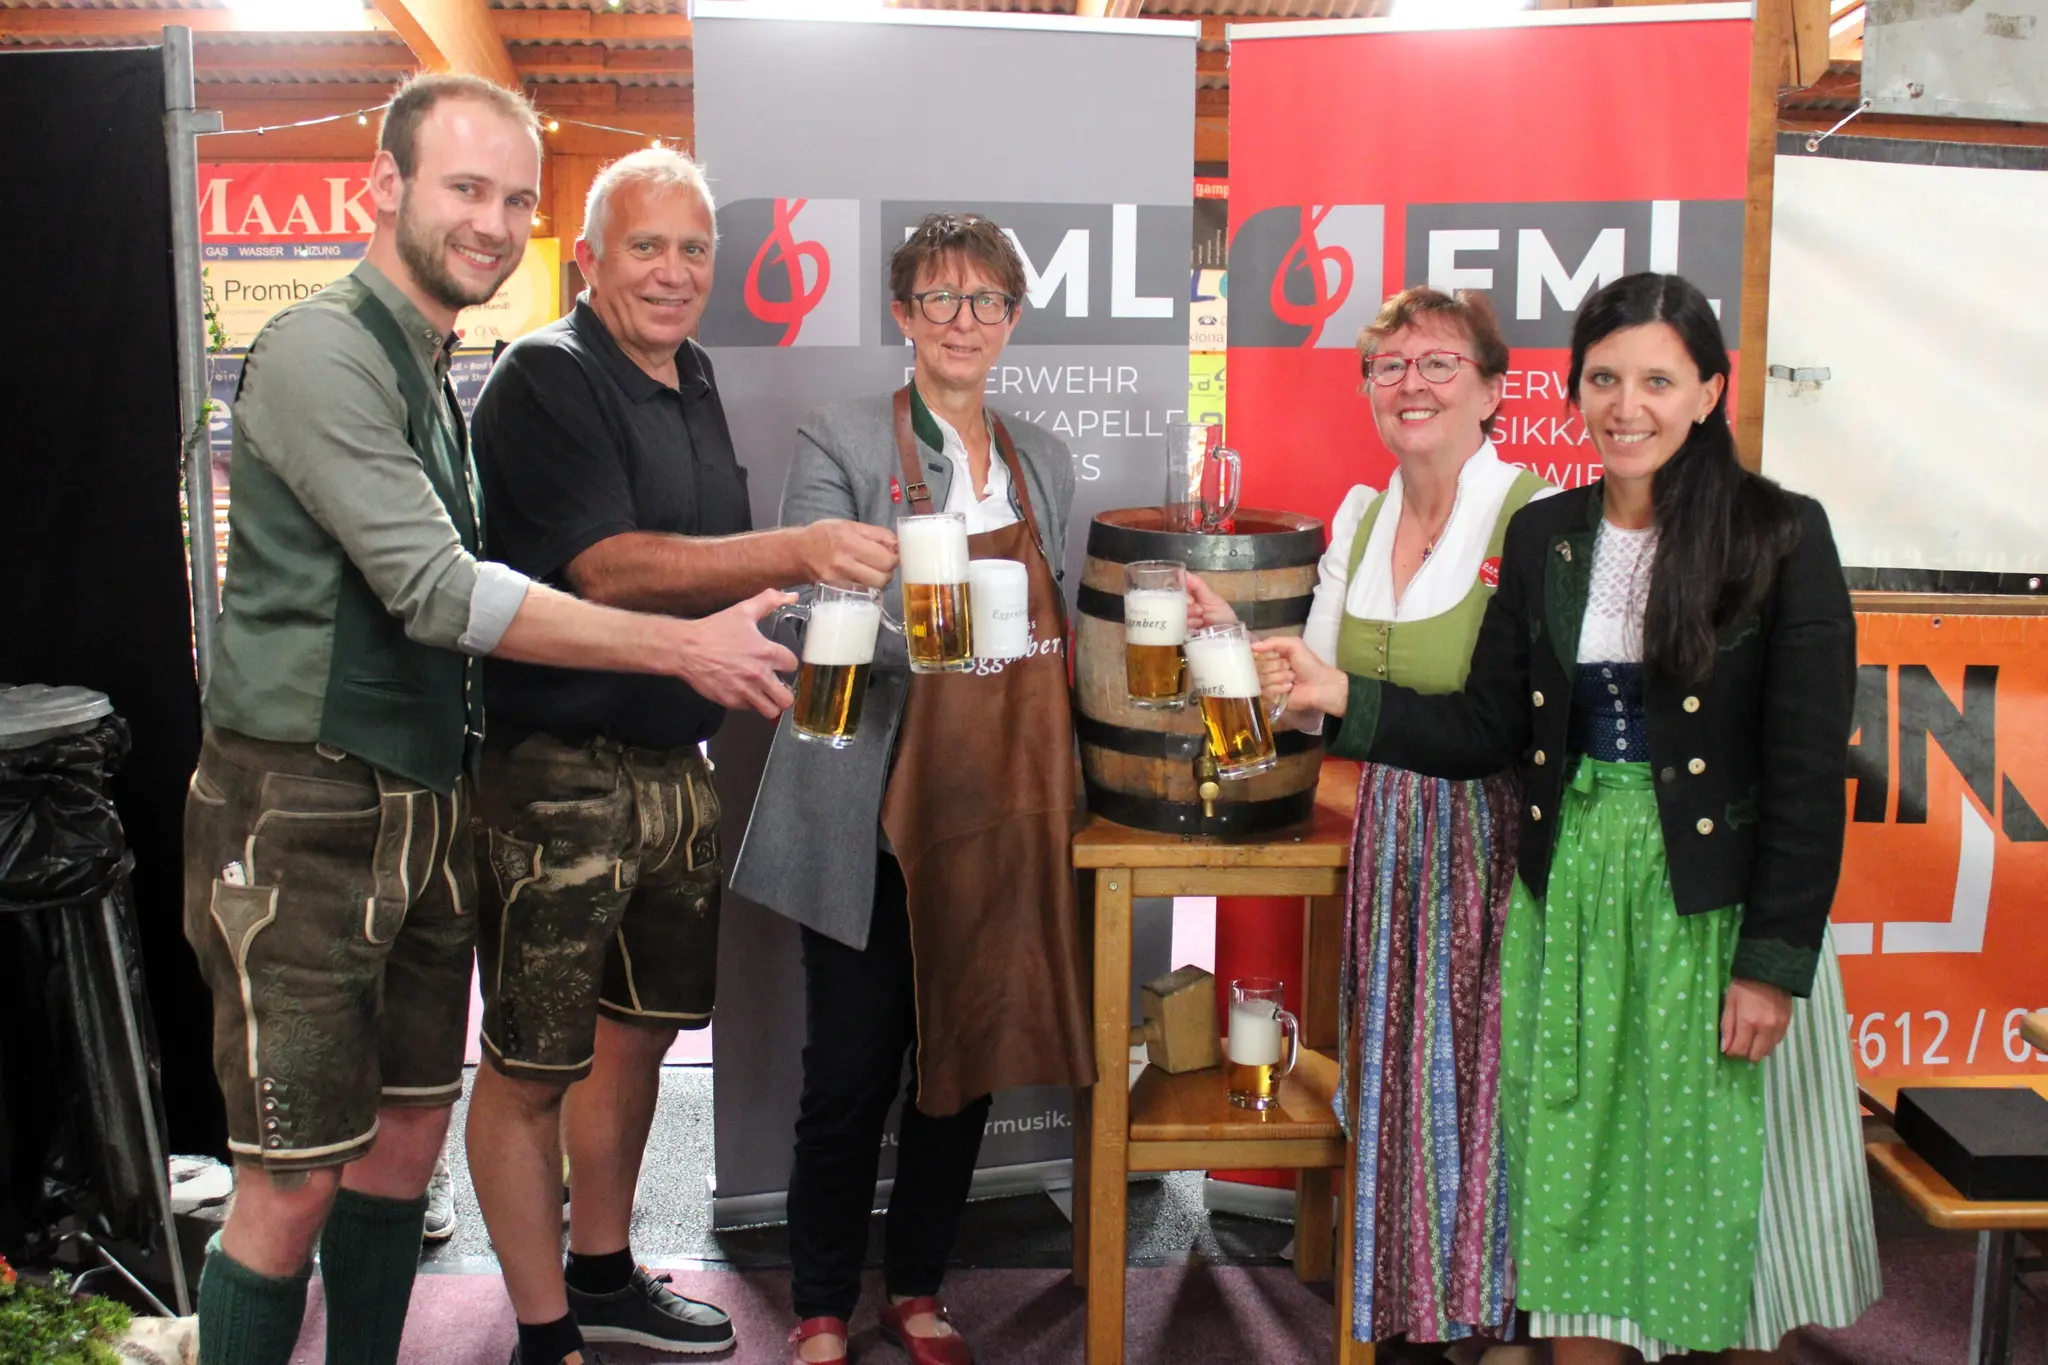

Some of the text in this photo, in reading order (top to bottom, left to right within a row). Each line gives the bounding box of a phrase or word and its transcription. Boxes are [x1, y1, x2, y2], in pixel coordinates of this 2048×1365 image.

[206, 246, 229, 257] GAS
[239, 246, 284, 257] WASSER
[225, 278, 330, 302] Prombe
